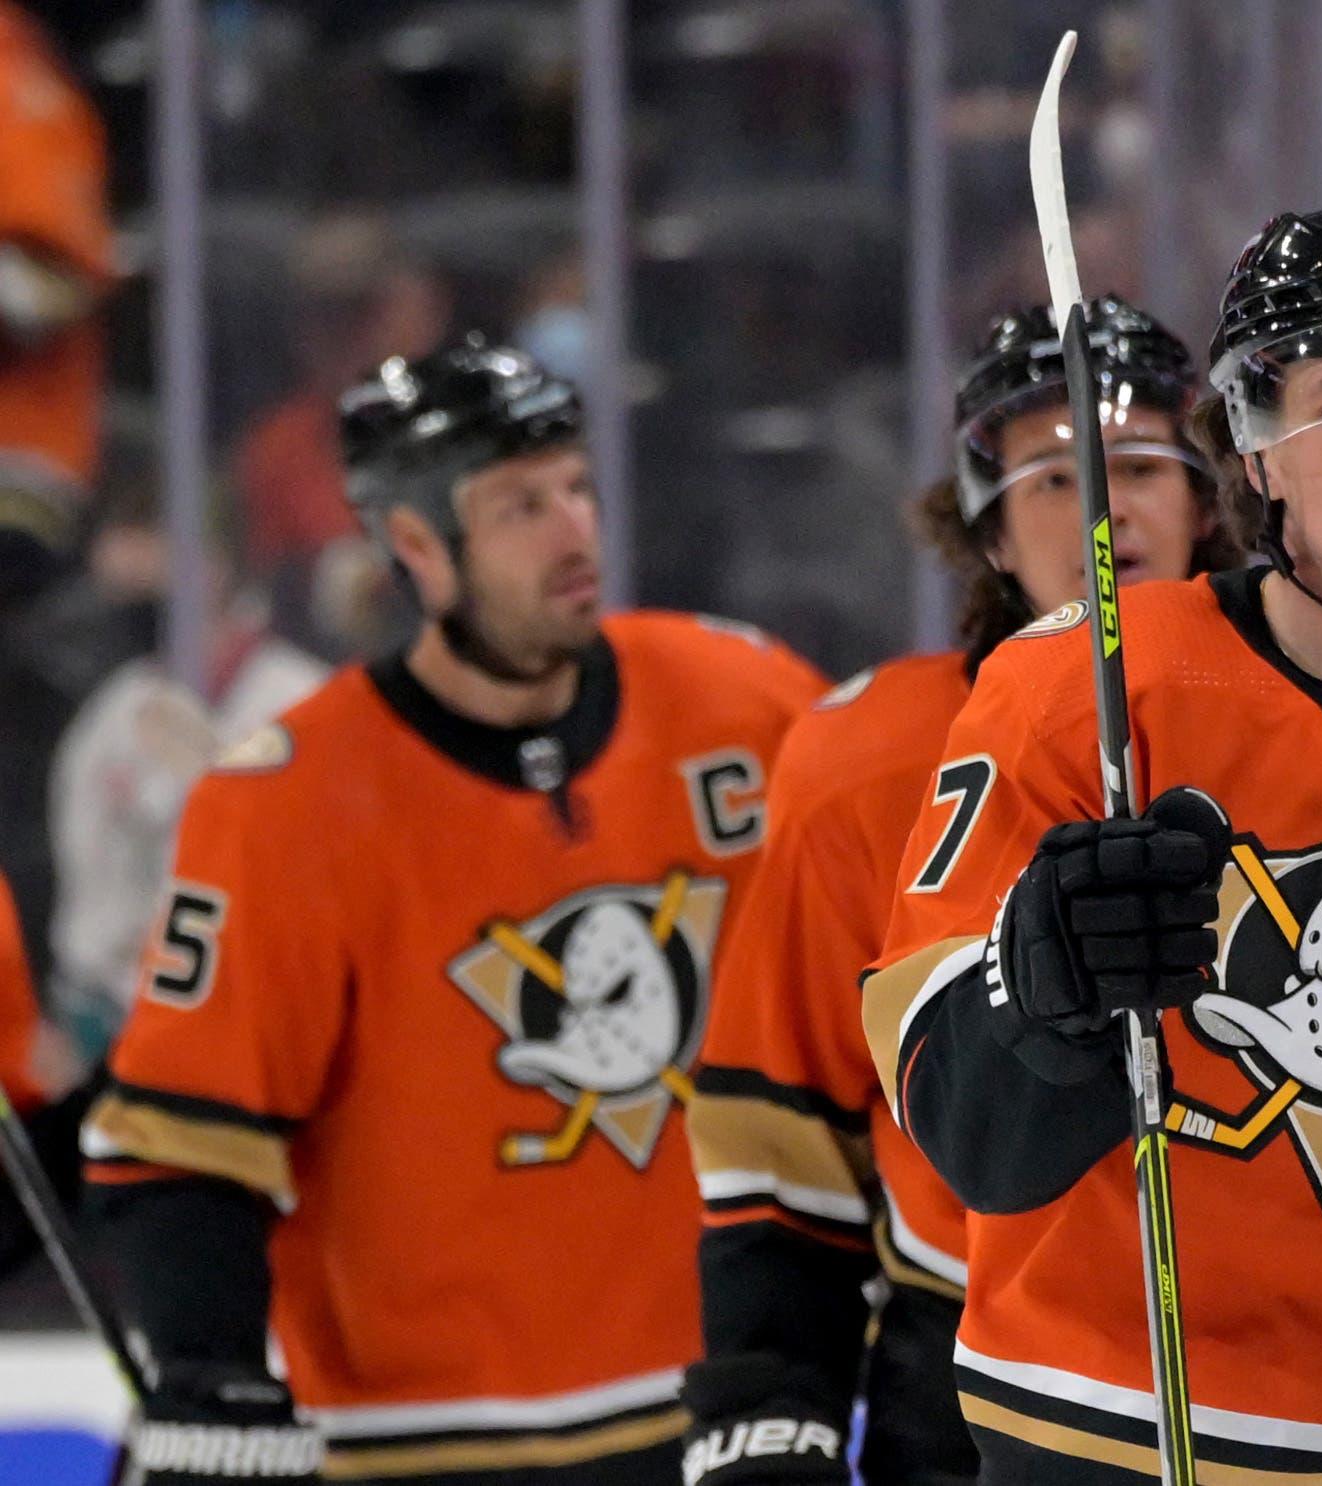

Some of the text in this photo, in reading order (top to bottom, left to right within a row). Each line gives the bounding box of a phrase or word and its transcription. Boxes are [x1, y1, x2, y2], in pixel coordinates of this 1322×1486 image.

[1096, 539, 1118, 639] CCM
[682, 747, 766, 856] C
[904, 752, 997, 894] 7
[148, 880, 230, 1010] 5
